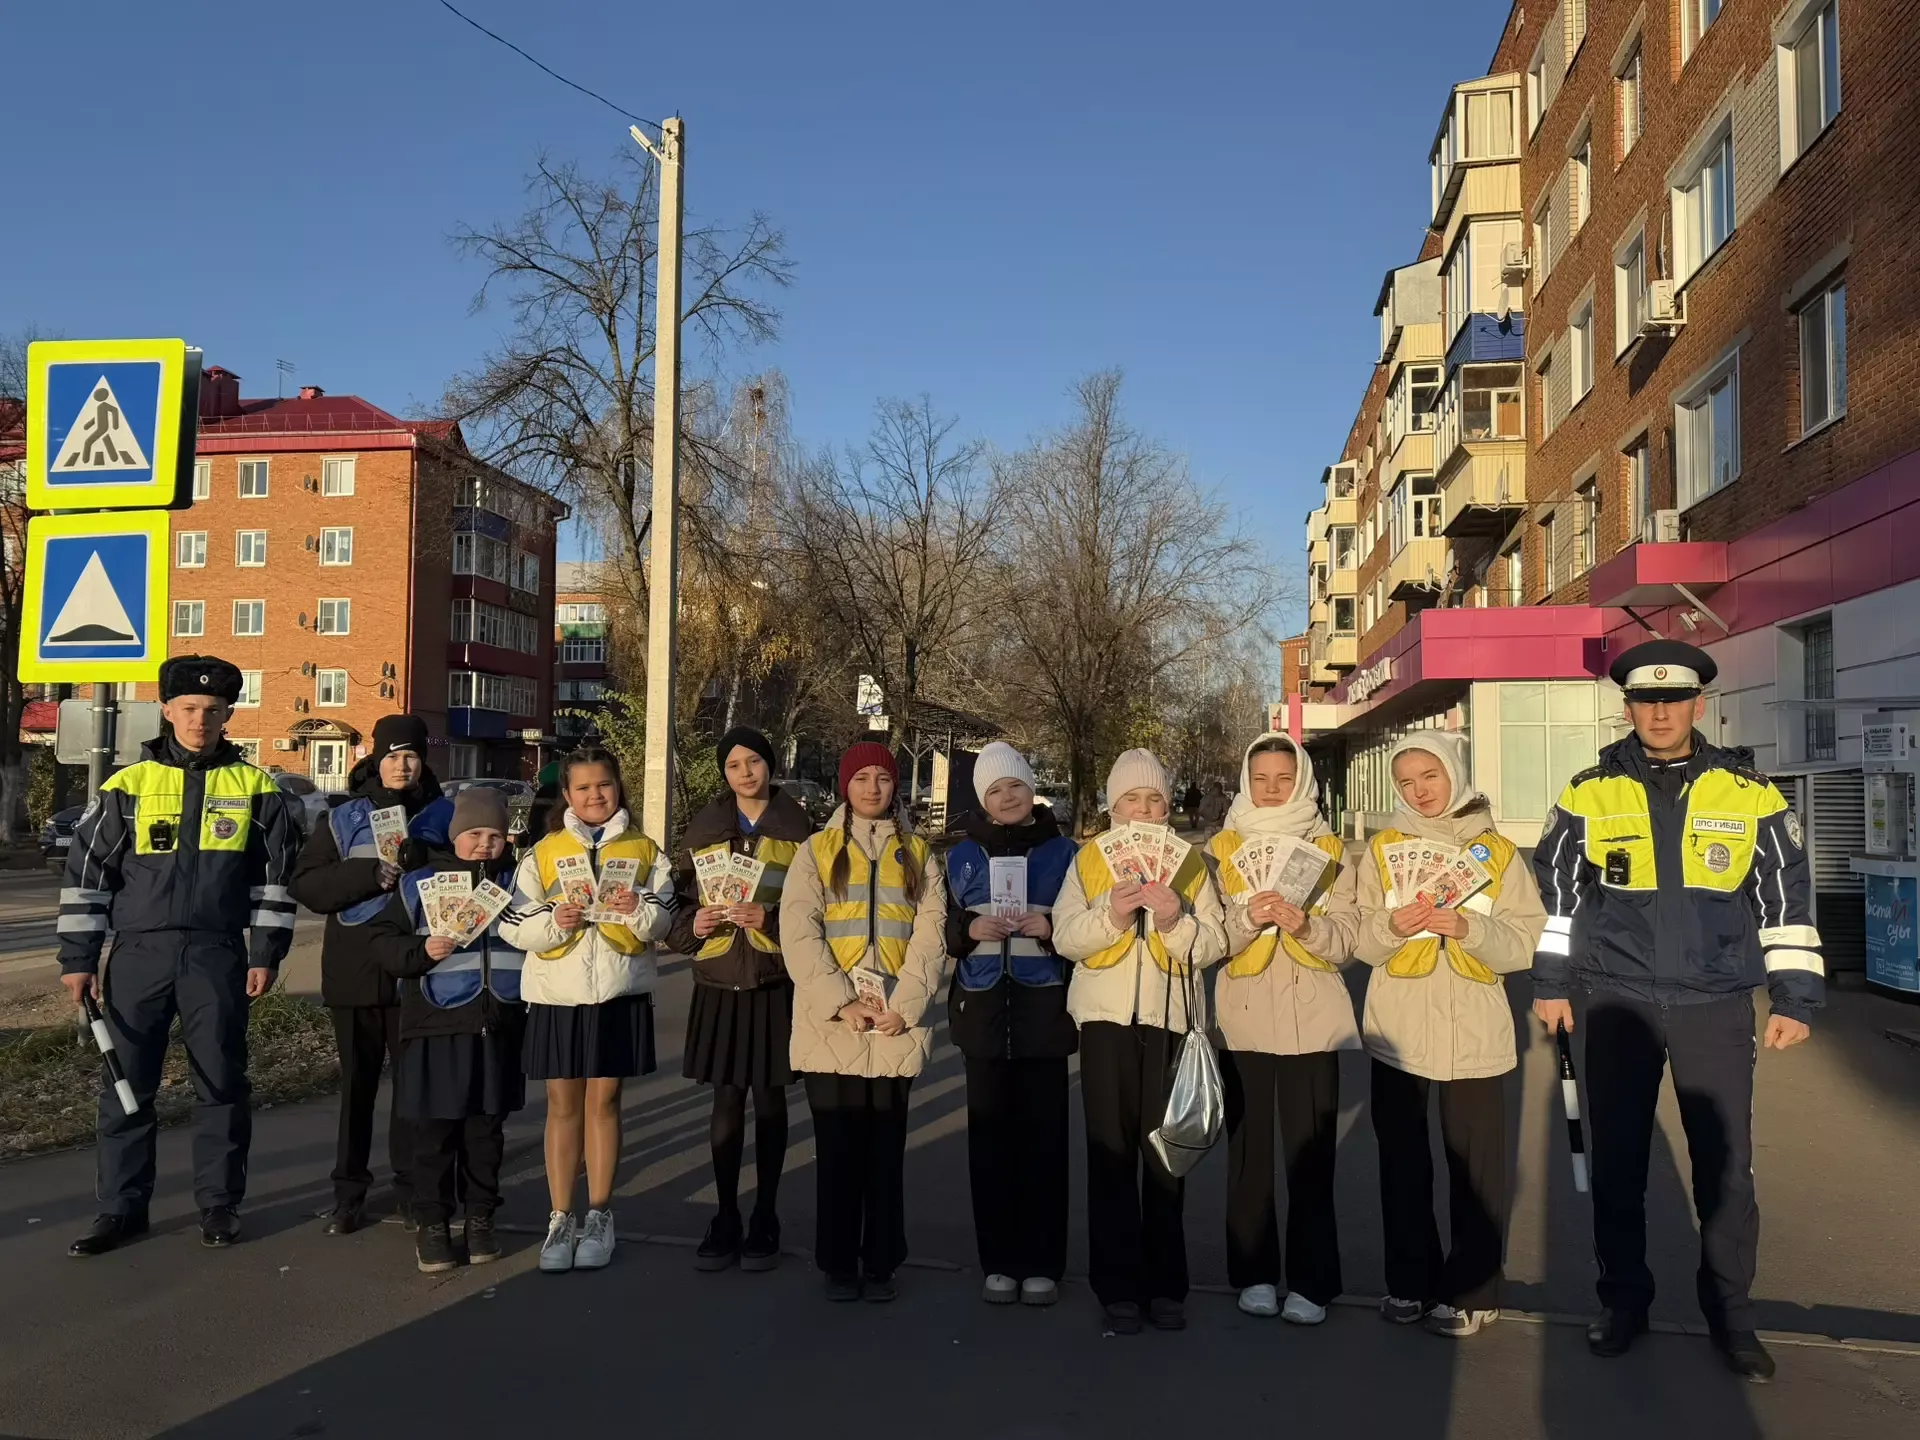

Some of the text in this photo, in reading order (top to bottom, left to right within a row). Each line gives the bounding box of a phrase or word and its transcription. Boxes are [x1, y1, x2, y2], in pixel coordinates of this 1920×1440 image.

[1694, 819, 1743, 831] ДПС ГИБДД
[1108, 845, 1135, 860] ПАМЯТКА
[700, 863, 727, 875] ПАМЯТКА
[1421, 859, 1446, 869] ПАМЯТ
[560, 867, 588, 876] ПАМЯТКА
[731, 865, 757, 878] ПАМЯТКА
[1450, 866, 1473, 891] ПАМЯТКА
[475, 891, 500, 909] ПАМЯТКА
